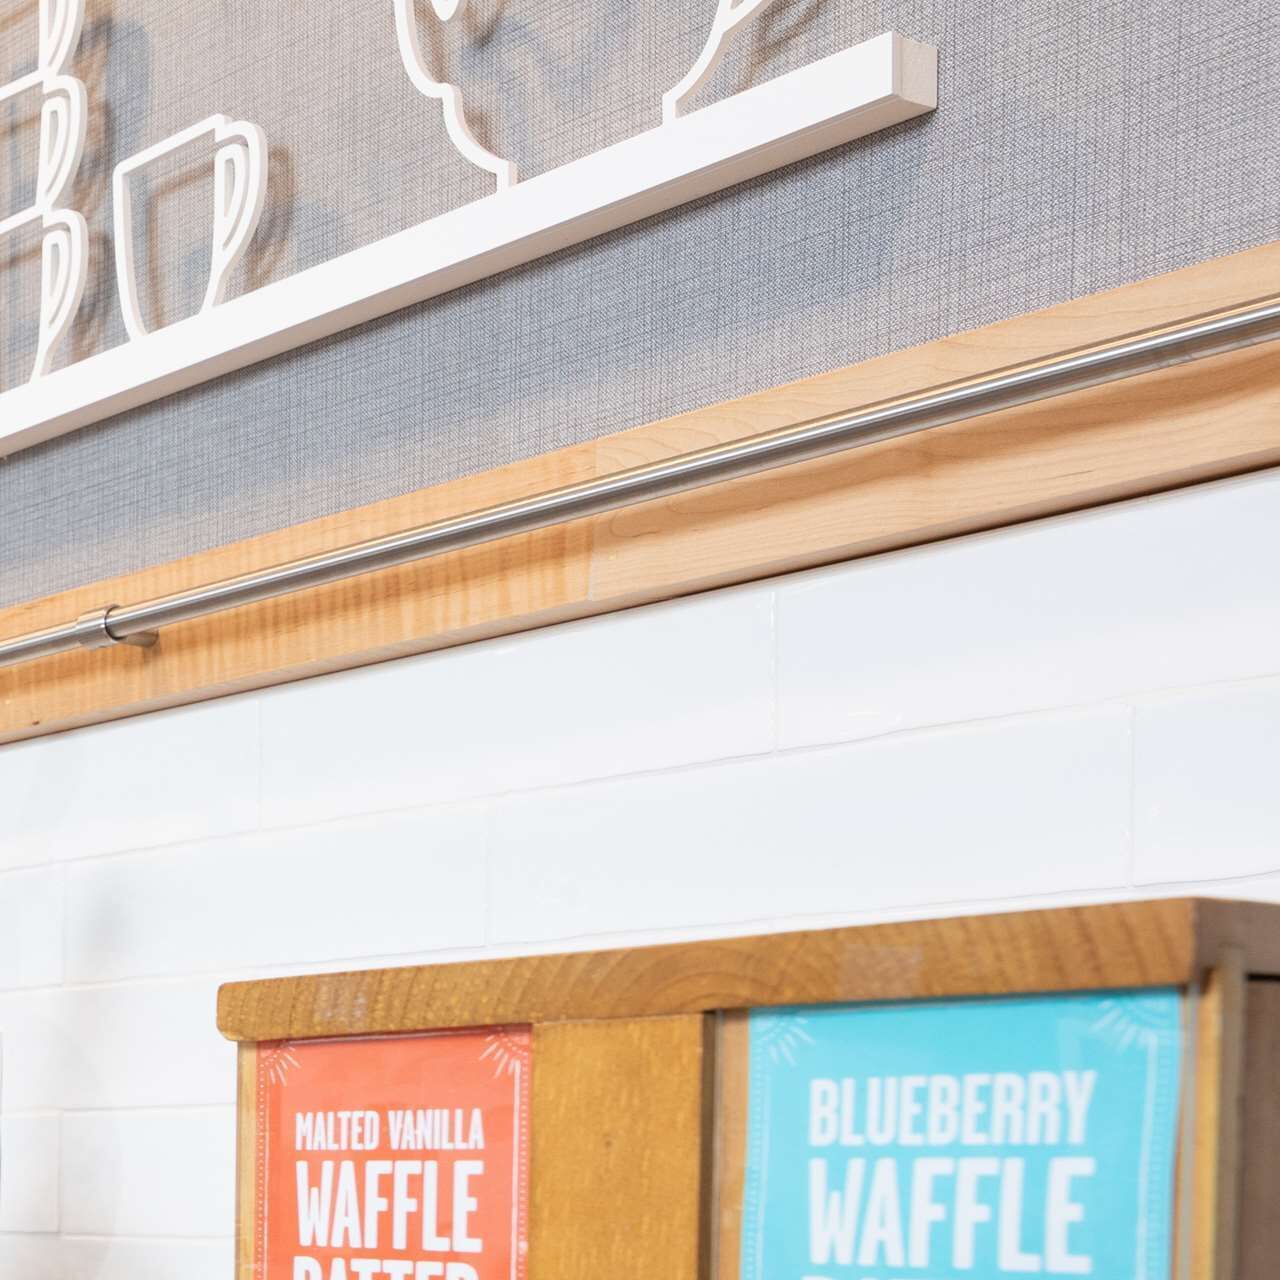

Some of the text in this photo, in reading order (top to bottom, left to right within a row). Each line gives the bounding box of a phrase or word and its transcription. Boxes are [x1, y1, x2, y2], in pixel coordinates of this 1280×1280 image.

[295, 1107, 485, 1151] MALTED VANILLA
[808, 1070, 1098, 1147] BLUEBERRY
[296, 1160, 484, 1253] WAFFLE
[808, 1157, 1096, 1275] WAFFLE
